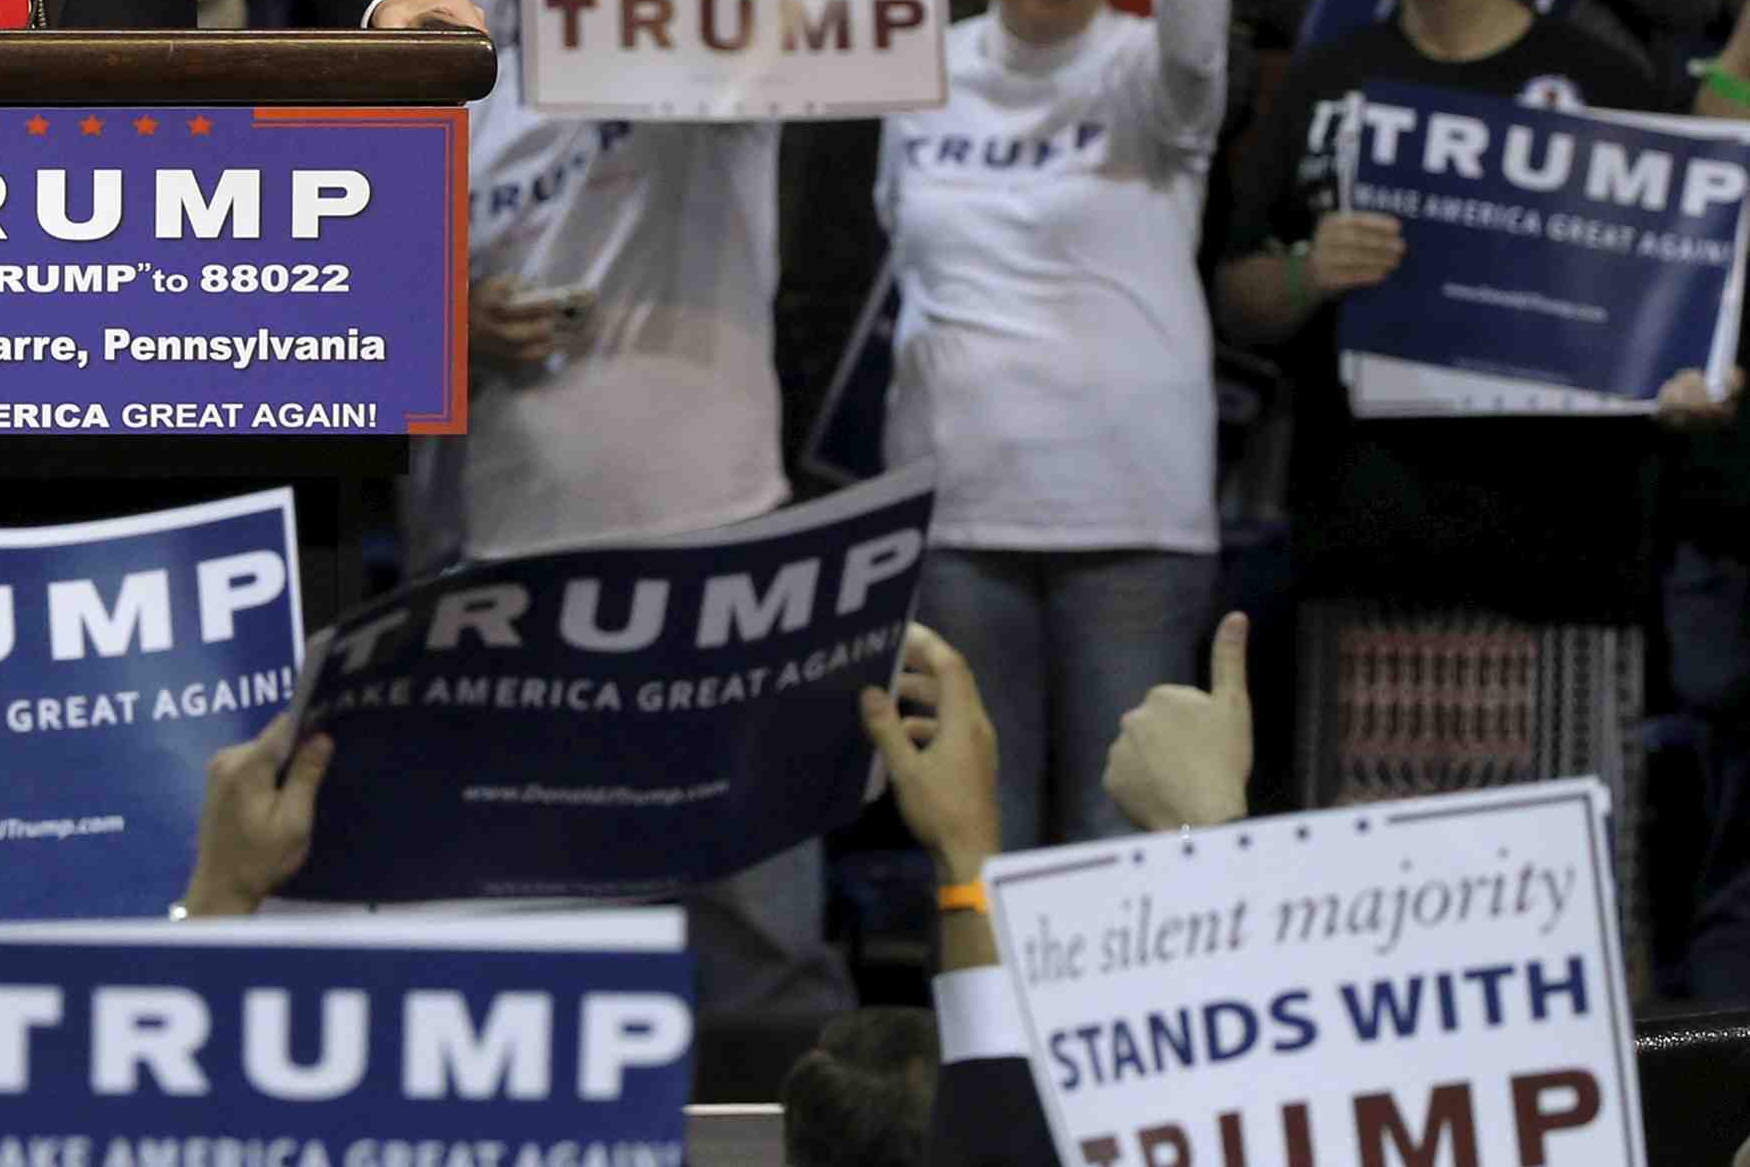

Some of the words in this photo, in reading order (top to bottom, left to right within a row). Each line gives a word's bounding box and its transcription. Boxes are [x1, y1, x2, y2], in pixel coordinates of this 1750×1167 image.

[1362, 103, 1748, 218] TRUMP
[201, 264, 350, 293] 88022
[104, 328, 386, 369] Pennsylvania
[121, 403, 243, 429] GREAT
[252, 403, 378, 429] AGAIN!
[332, 528, 925, 672] TRUMP
[6, 691, 140, 733] GREAT
[152, 666, 296, 721] AGAIN!
[422, 677, 622, 712] AMERICA
[636, 667, 769, 713] GREAT
[776, 625, 900, 690] AGAIN!
[1023, 916, 1086, 987] the
[1100, 897, 1249, 974] silent
[1274, 848, 1578, 954] majority
[1050, 989, 1318, 1090] STANDS
[1341, 954, 1591, 1044] WITH
[109, 1135, 329, 1167] AMERICA
